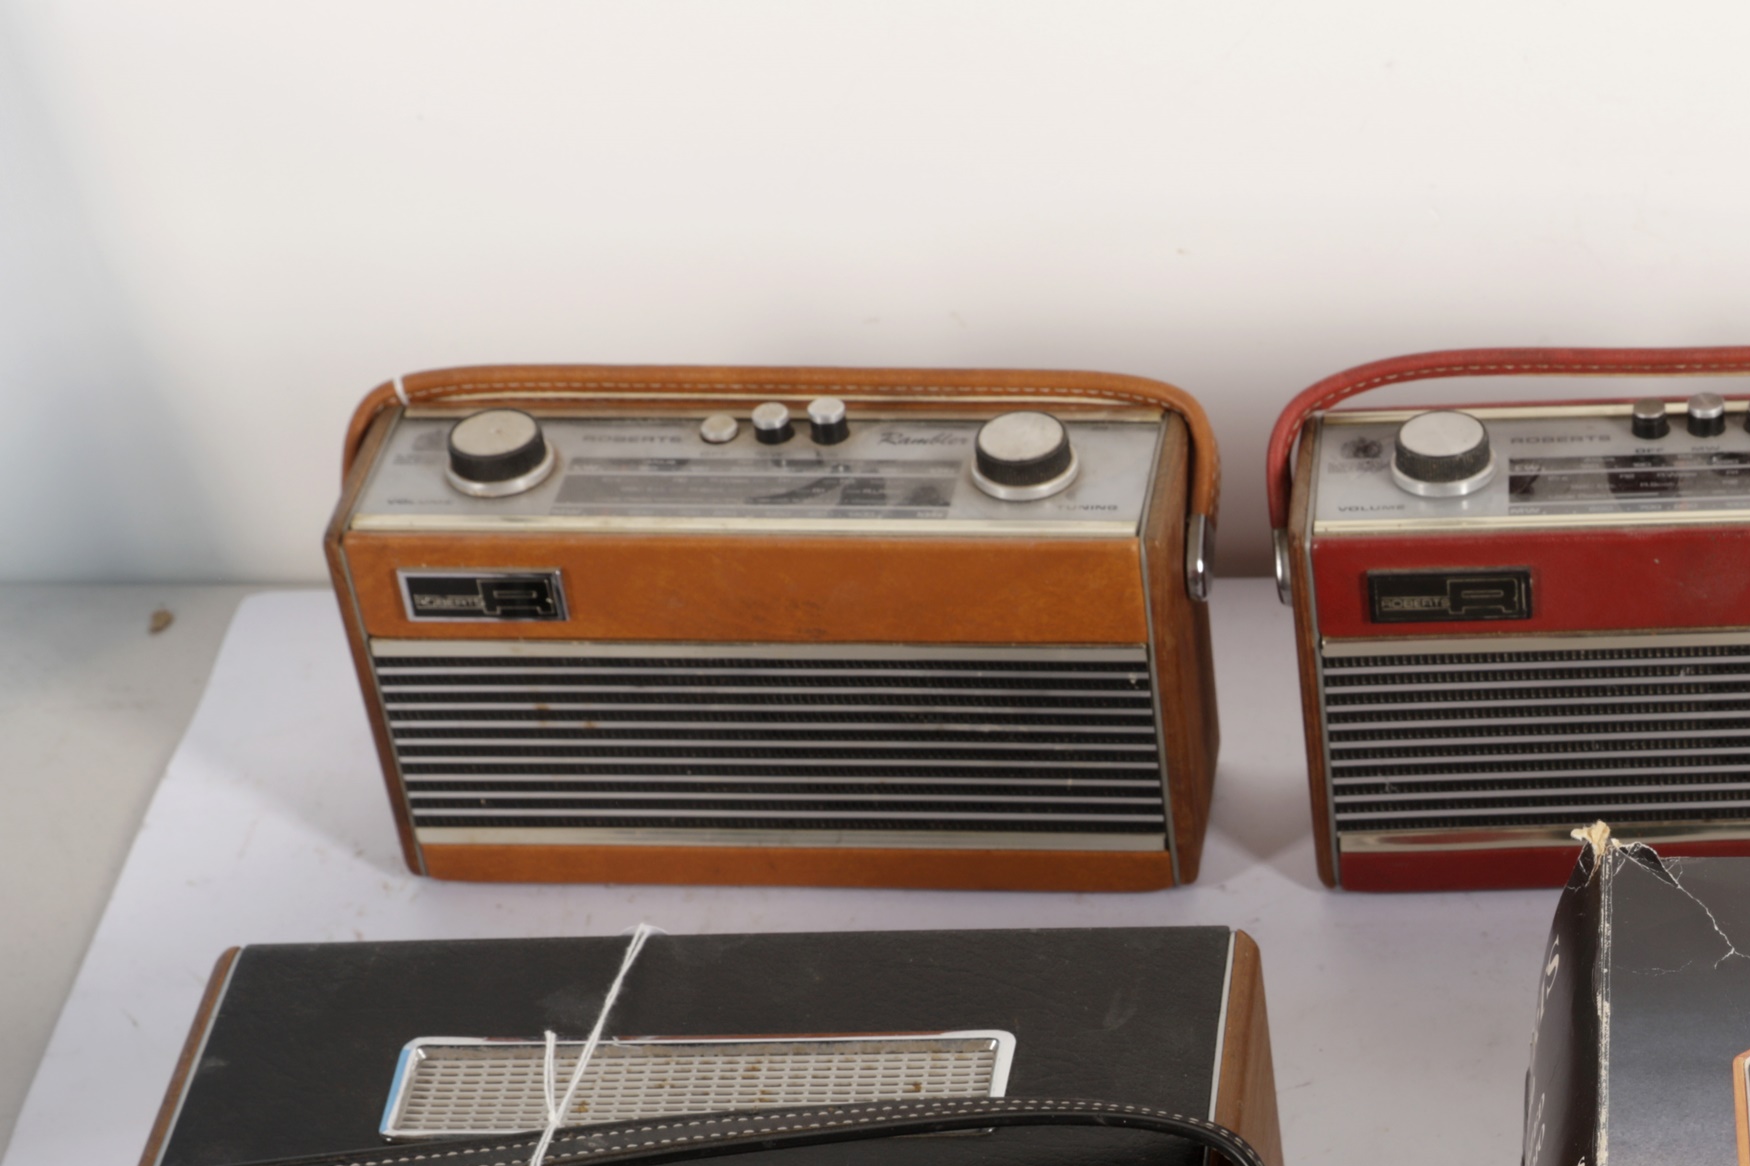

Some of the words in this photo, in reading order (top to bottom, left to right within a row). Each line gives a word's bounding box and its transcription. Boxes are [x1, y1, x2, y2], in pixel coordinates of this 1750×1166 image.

[582, 433, 684, 443] ROBERTS
[878, 430, 969, 446] Rambler
[1510, 434, 1611, 445] ROBERTS
[1057, 503, 1118, 511] TUNING
[1338, 503, 1406, 512] VOLUME
[1381, 596, 1450, 611] ROBERTS
